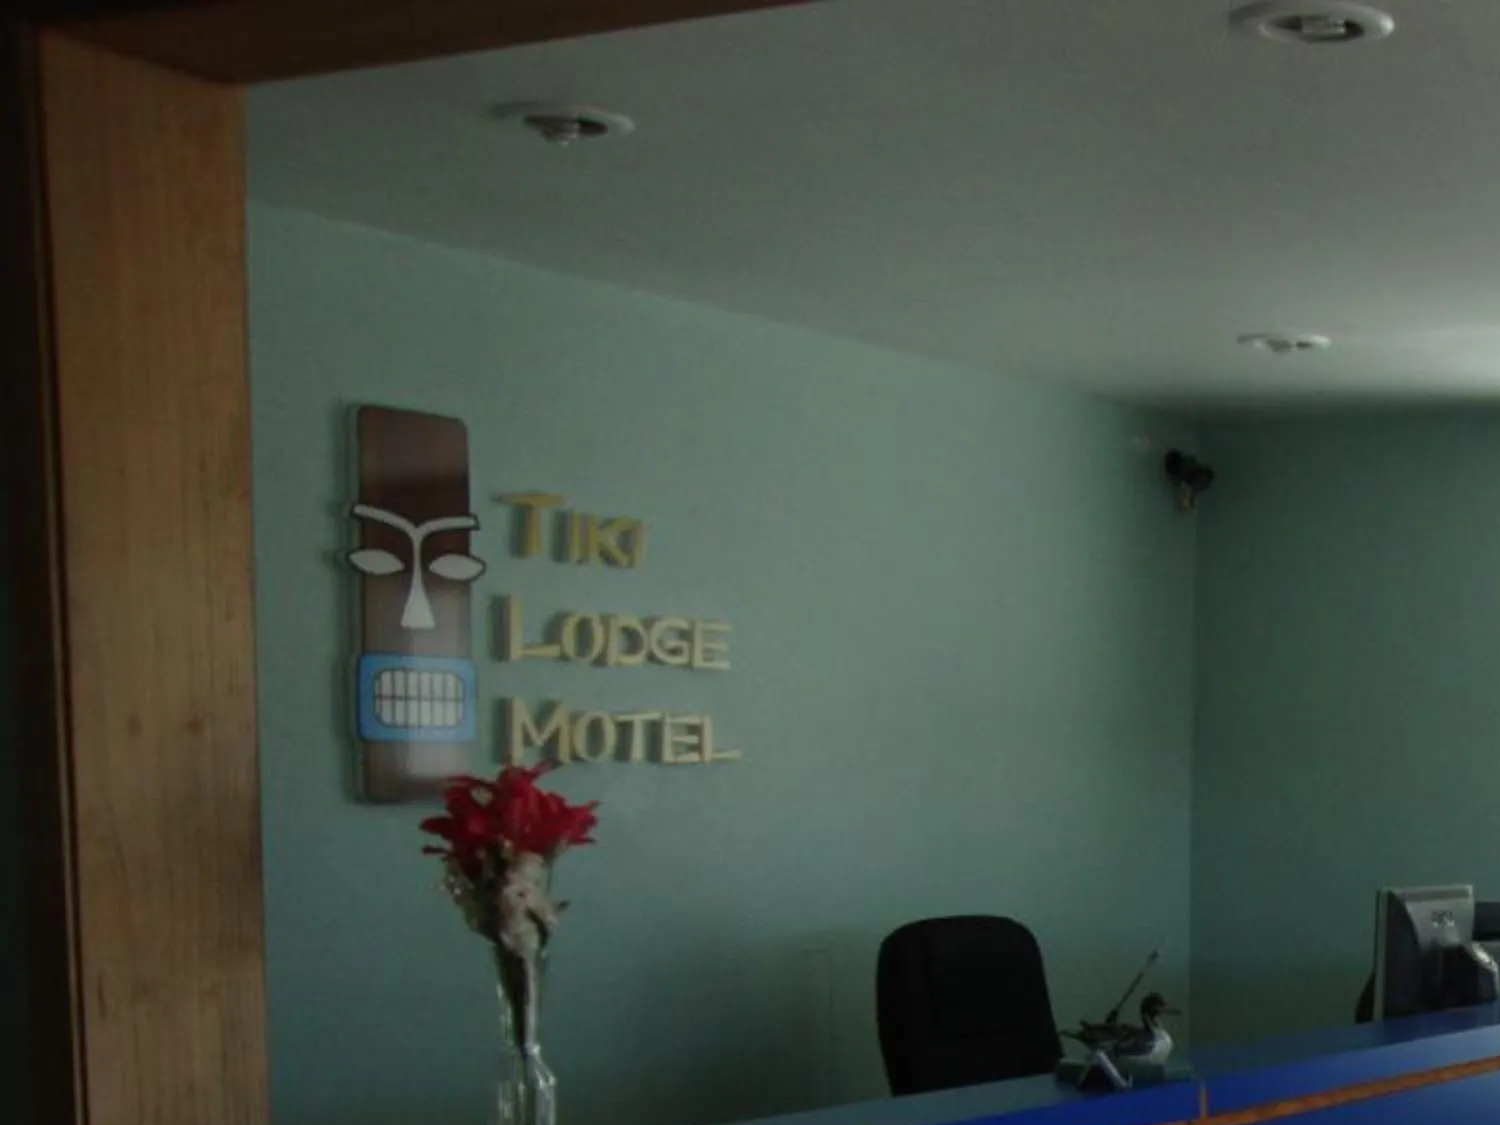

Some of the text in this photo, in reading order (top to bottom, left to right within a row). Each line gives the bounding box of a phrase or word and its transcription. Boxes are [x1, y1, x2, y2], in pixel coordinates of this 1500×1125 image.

[501, 492, 646, 568] TIKI
[509, 597, 732, 670] LODGE
[511, 697, 742, 766] MOTEL
